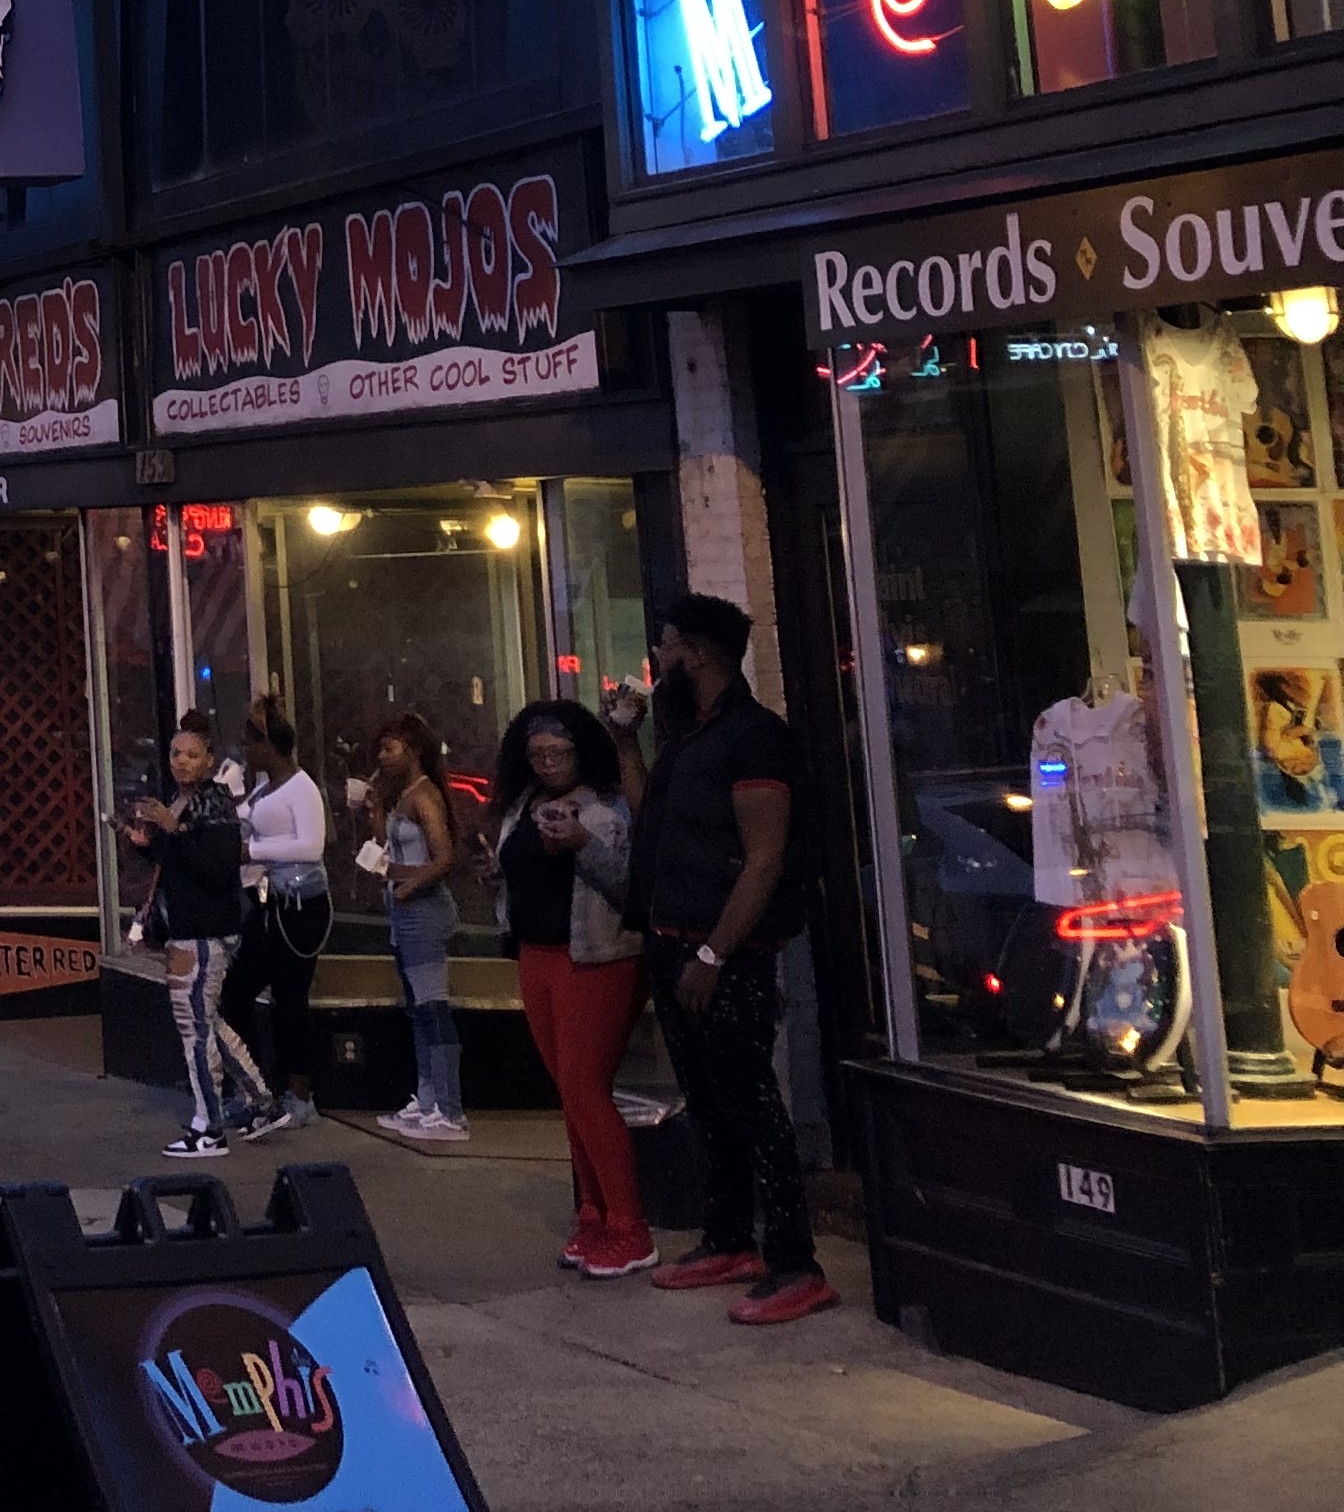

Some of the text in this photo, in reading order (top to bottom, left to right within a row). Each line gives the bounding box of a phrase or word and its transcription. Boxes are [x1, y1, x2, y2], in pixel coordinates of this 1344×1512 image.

[167, 173, 560, 382] LUCKY MOJOS
[814, 212, 1058, 331] Records
[166, 344, 579, 422] COLLECTABLES OTHER COOL STUFF
[18, 414, 92, 446] SOUVENIRS
[1066, 1166, 1110, 1209] 149
[139, 1339, 335, 1447] Memphis
